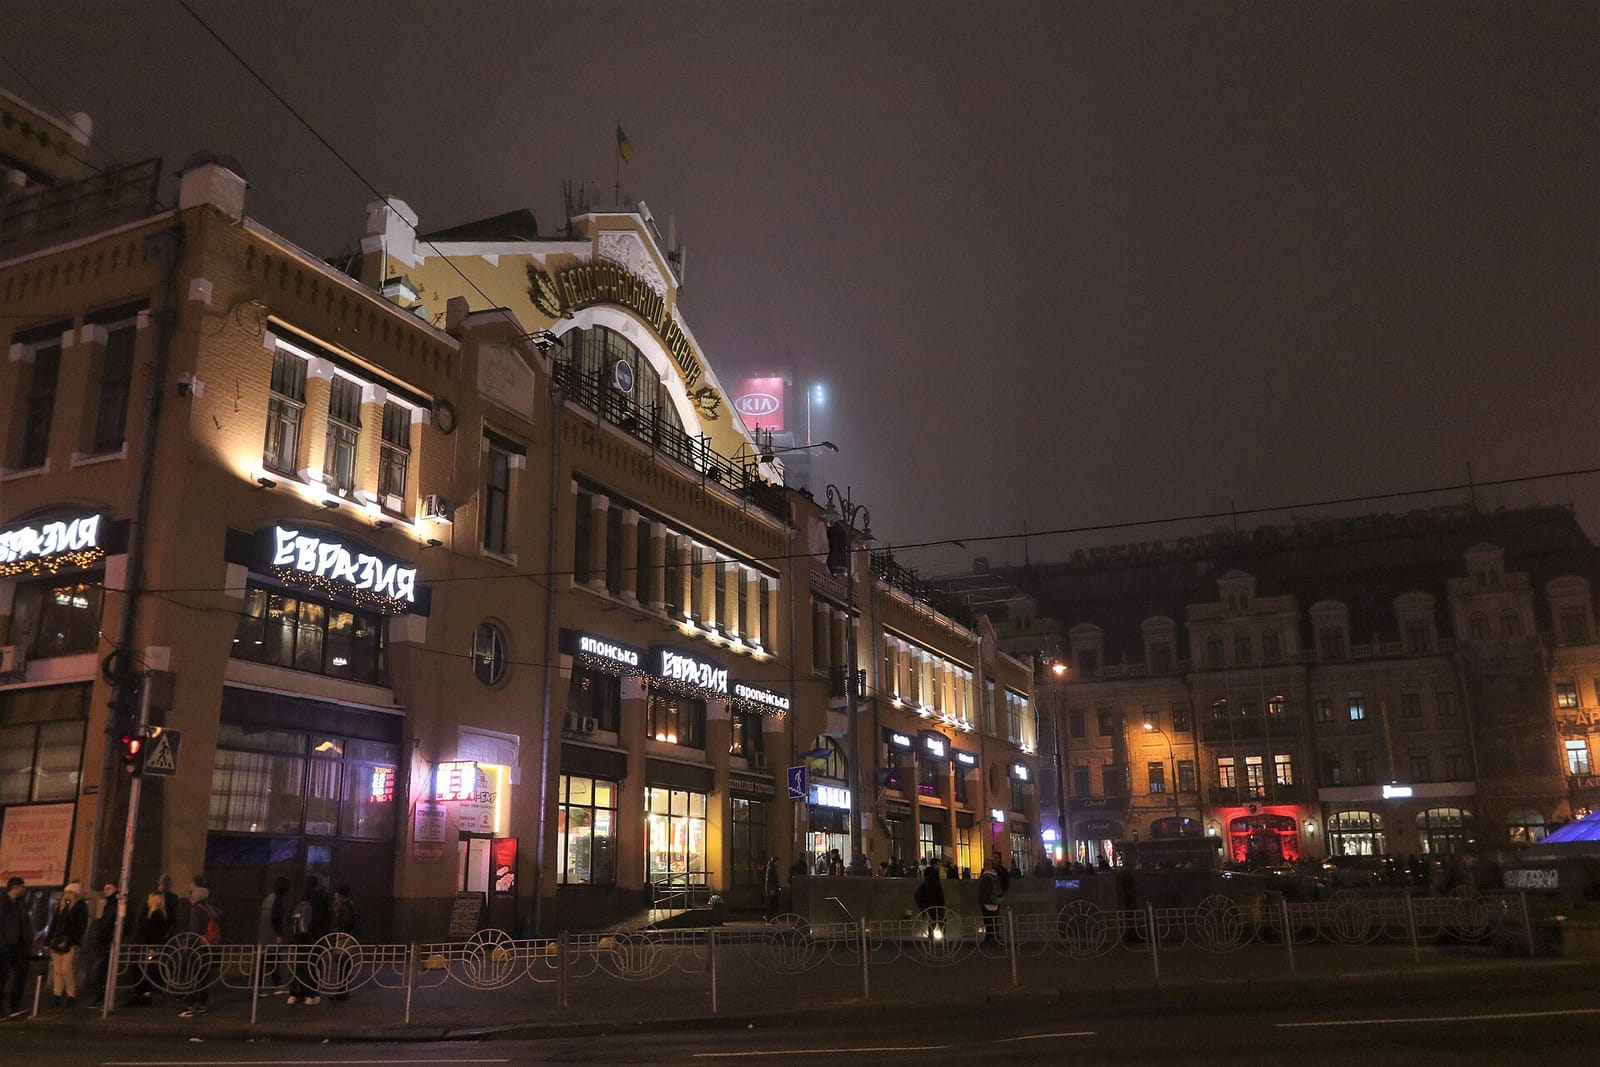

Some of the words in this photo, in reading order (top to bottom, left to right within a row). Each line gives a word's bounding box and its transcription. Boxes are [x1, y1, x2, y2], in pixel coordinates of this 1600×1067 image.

[665, 319, 702, 386] РИНОК
[742, 398, 772, 411] KIA
[273, 525, 418, 603] ЕВРАЗИЯ
[580, 636, 638, 666] японська
[662, 649, 728, 694] ЕВРАЗИЯ
